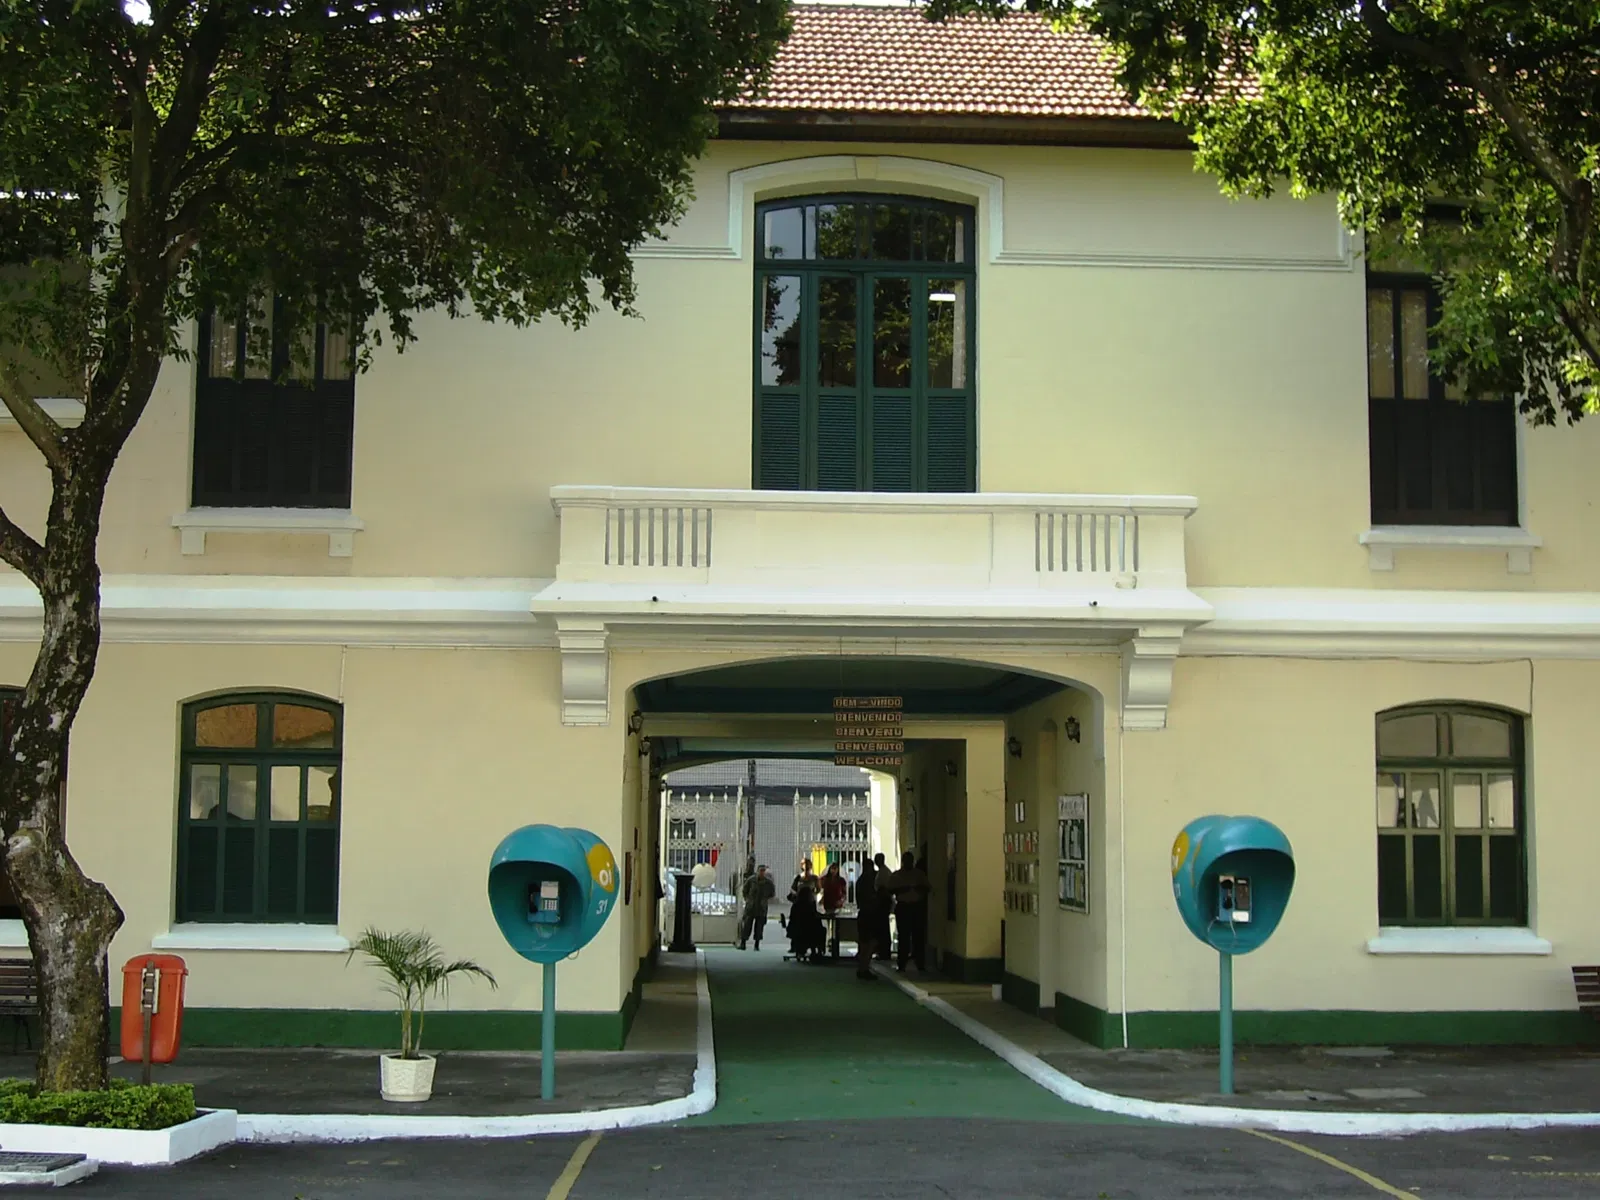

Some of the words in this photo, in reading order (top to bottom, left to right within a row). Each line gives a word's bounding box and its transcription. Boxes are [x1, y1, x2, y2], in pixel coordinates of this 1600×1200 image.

[835, 713, 902, 722] BIENVENIDO
[836, 728, 902, 736] BIENVENU
[836, 742, 902, 751] BENVENUTO
[836, 757, 902, 765] WELCOME
[596, 899, 608, 915] 31
